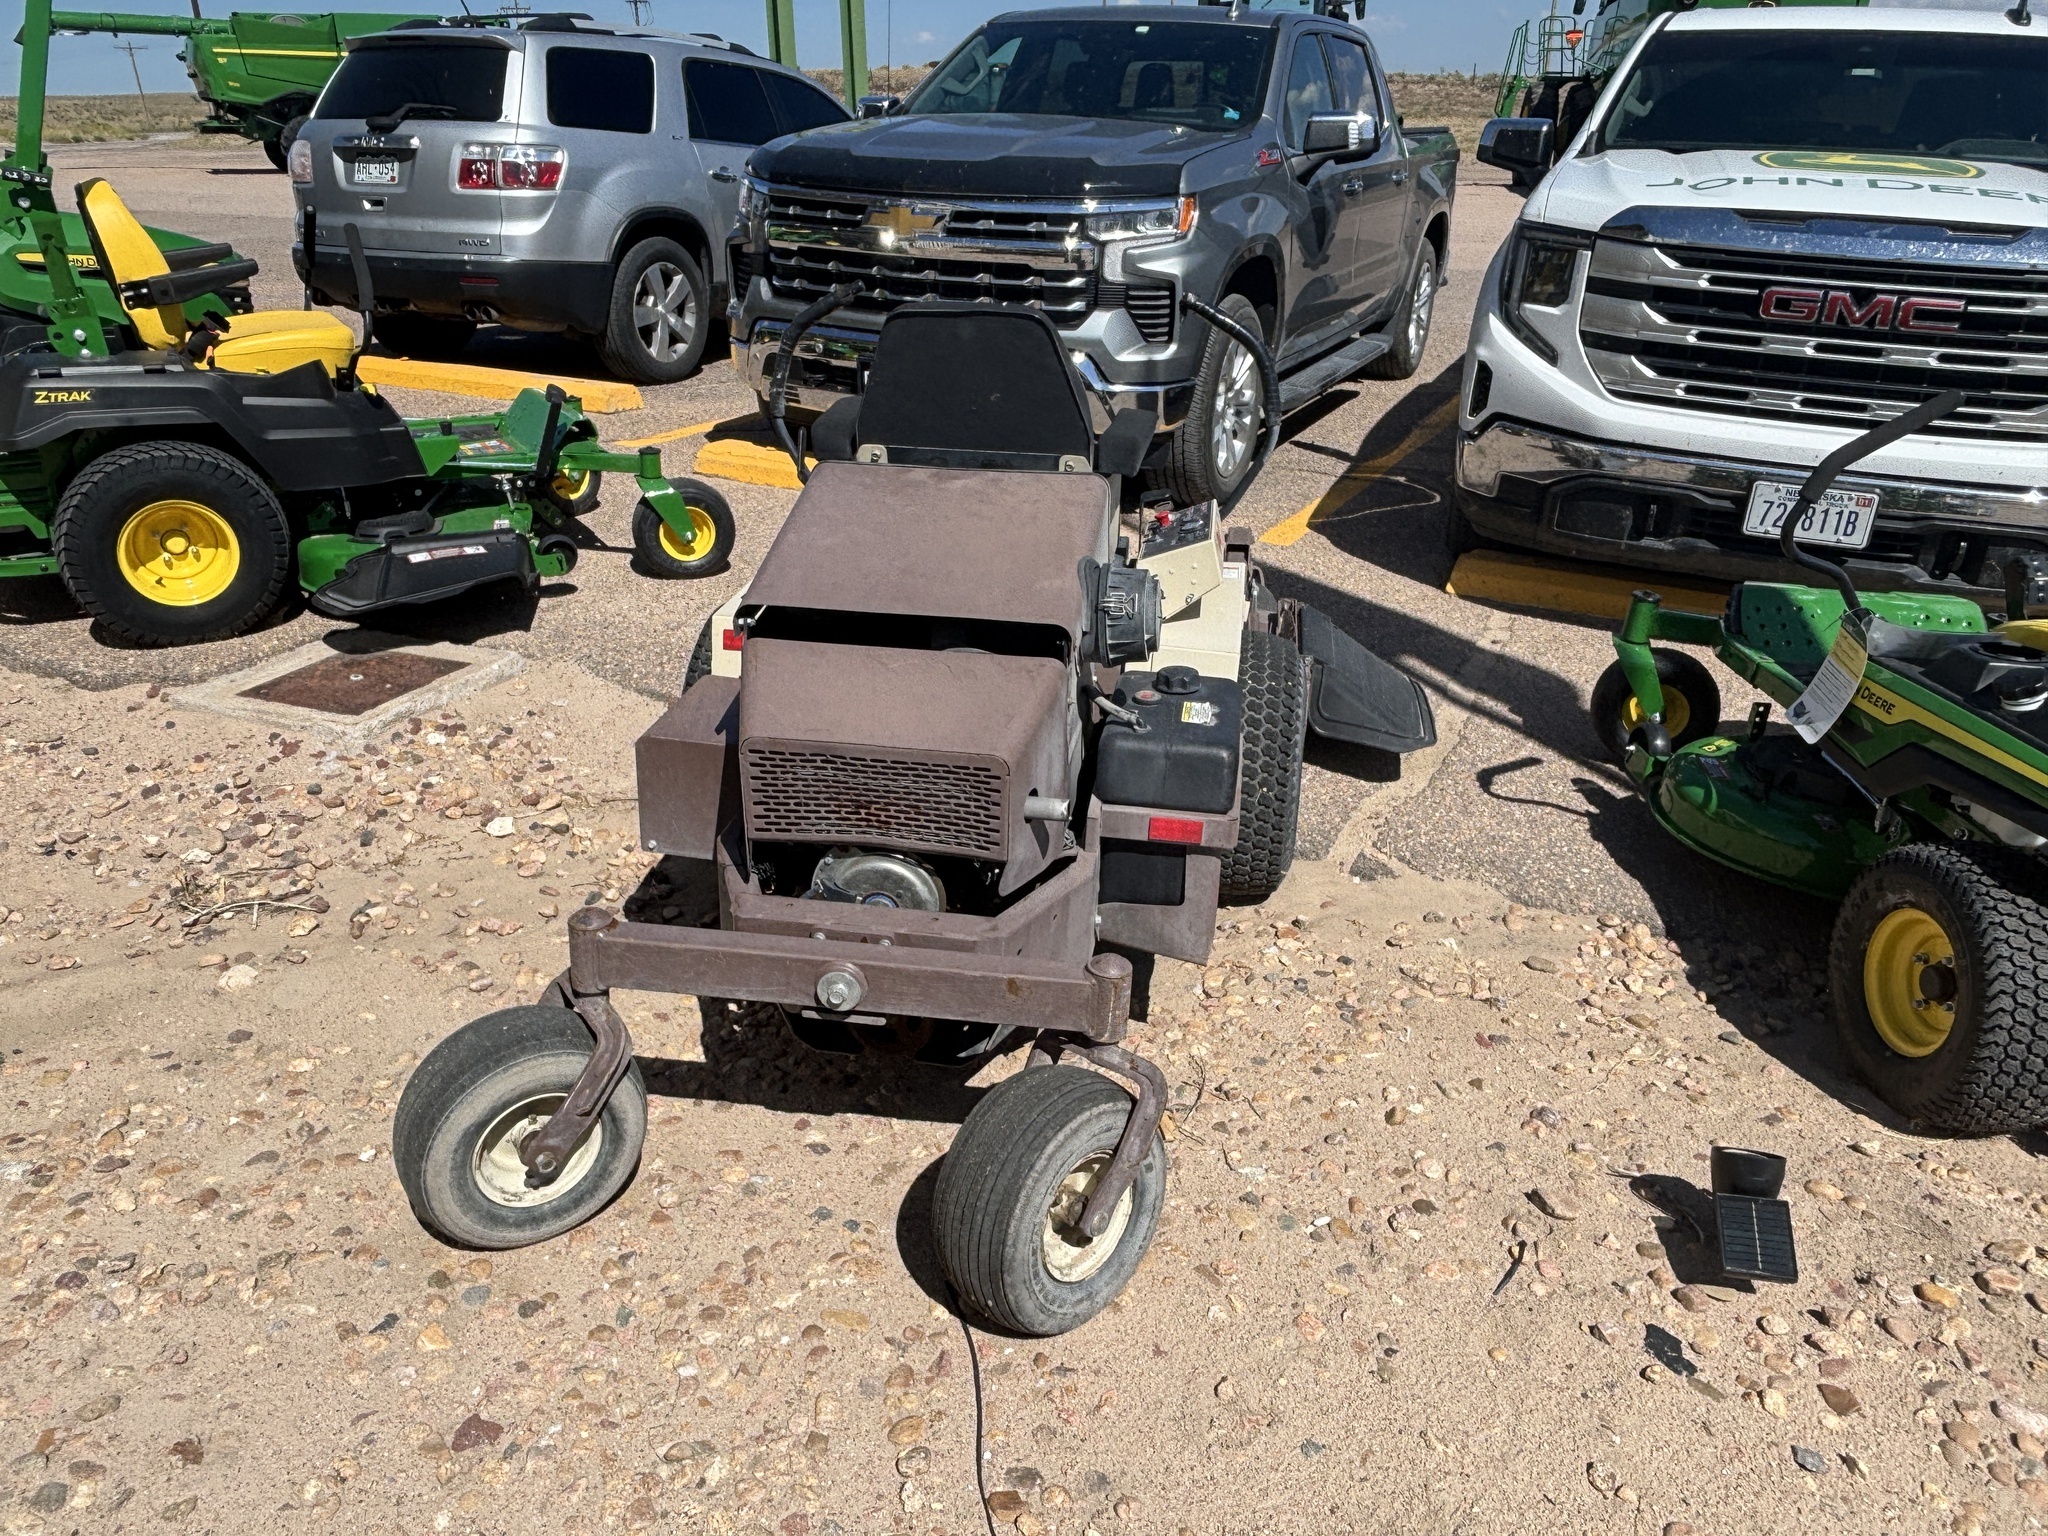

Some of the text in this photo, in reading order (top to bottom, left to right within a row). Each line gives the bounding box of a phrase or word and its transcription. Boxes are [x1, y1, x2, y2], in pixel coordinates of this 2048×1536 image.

[1645, 176, 1844, 191] JOHN
[1760, 286, 1966, 333] GMC
[34, 390, 92, 404] ZTRAK
[1860, 685, 1896, 716] DEERE
